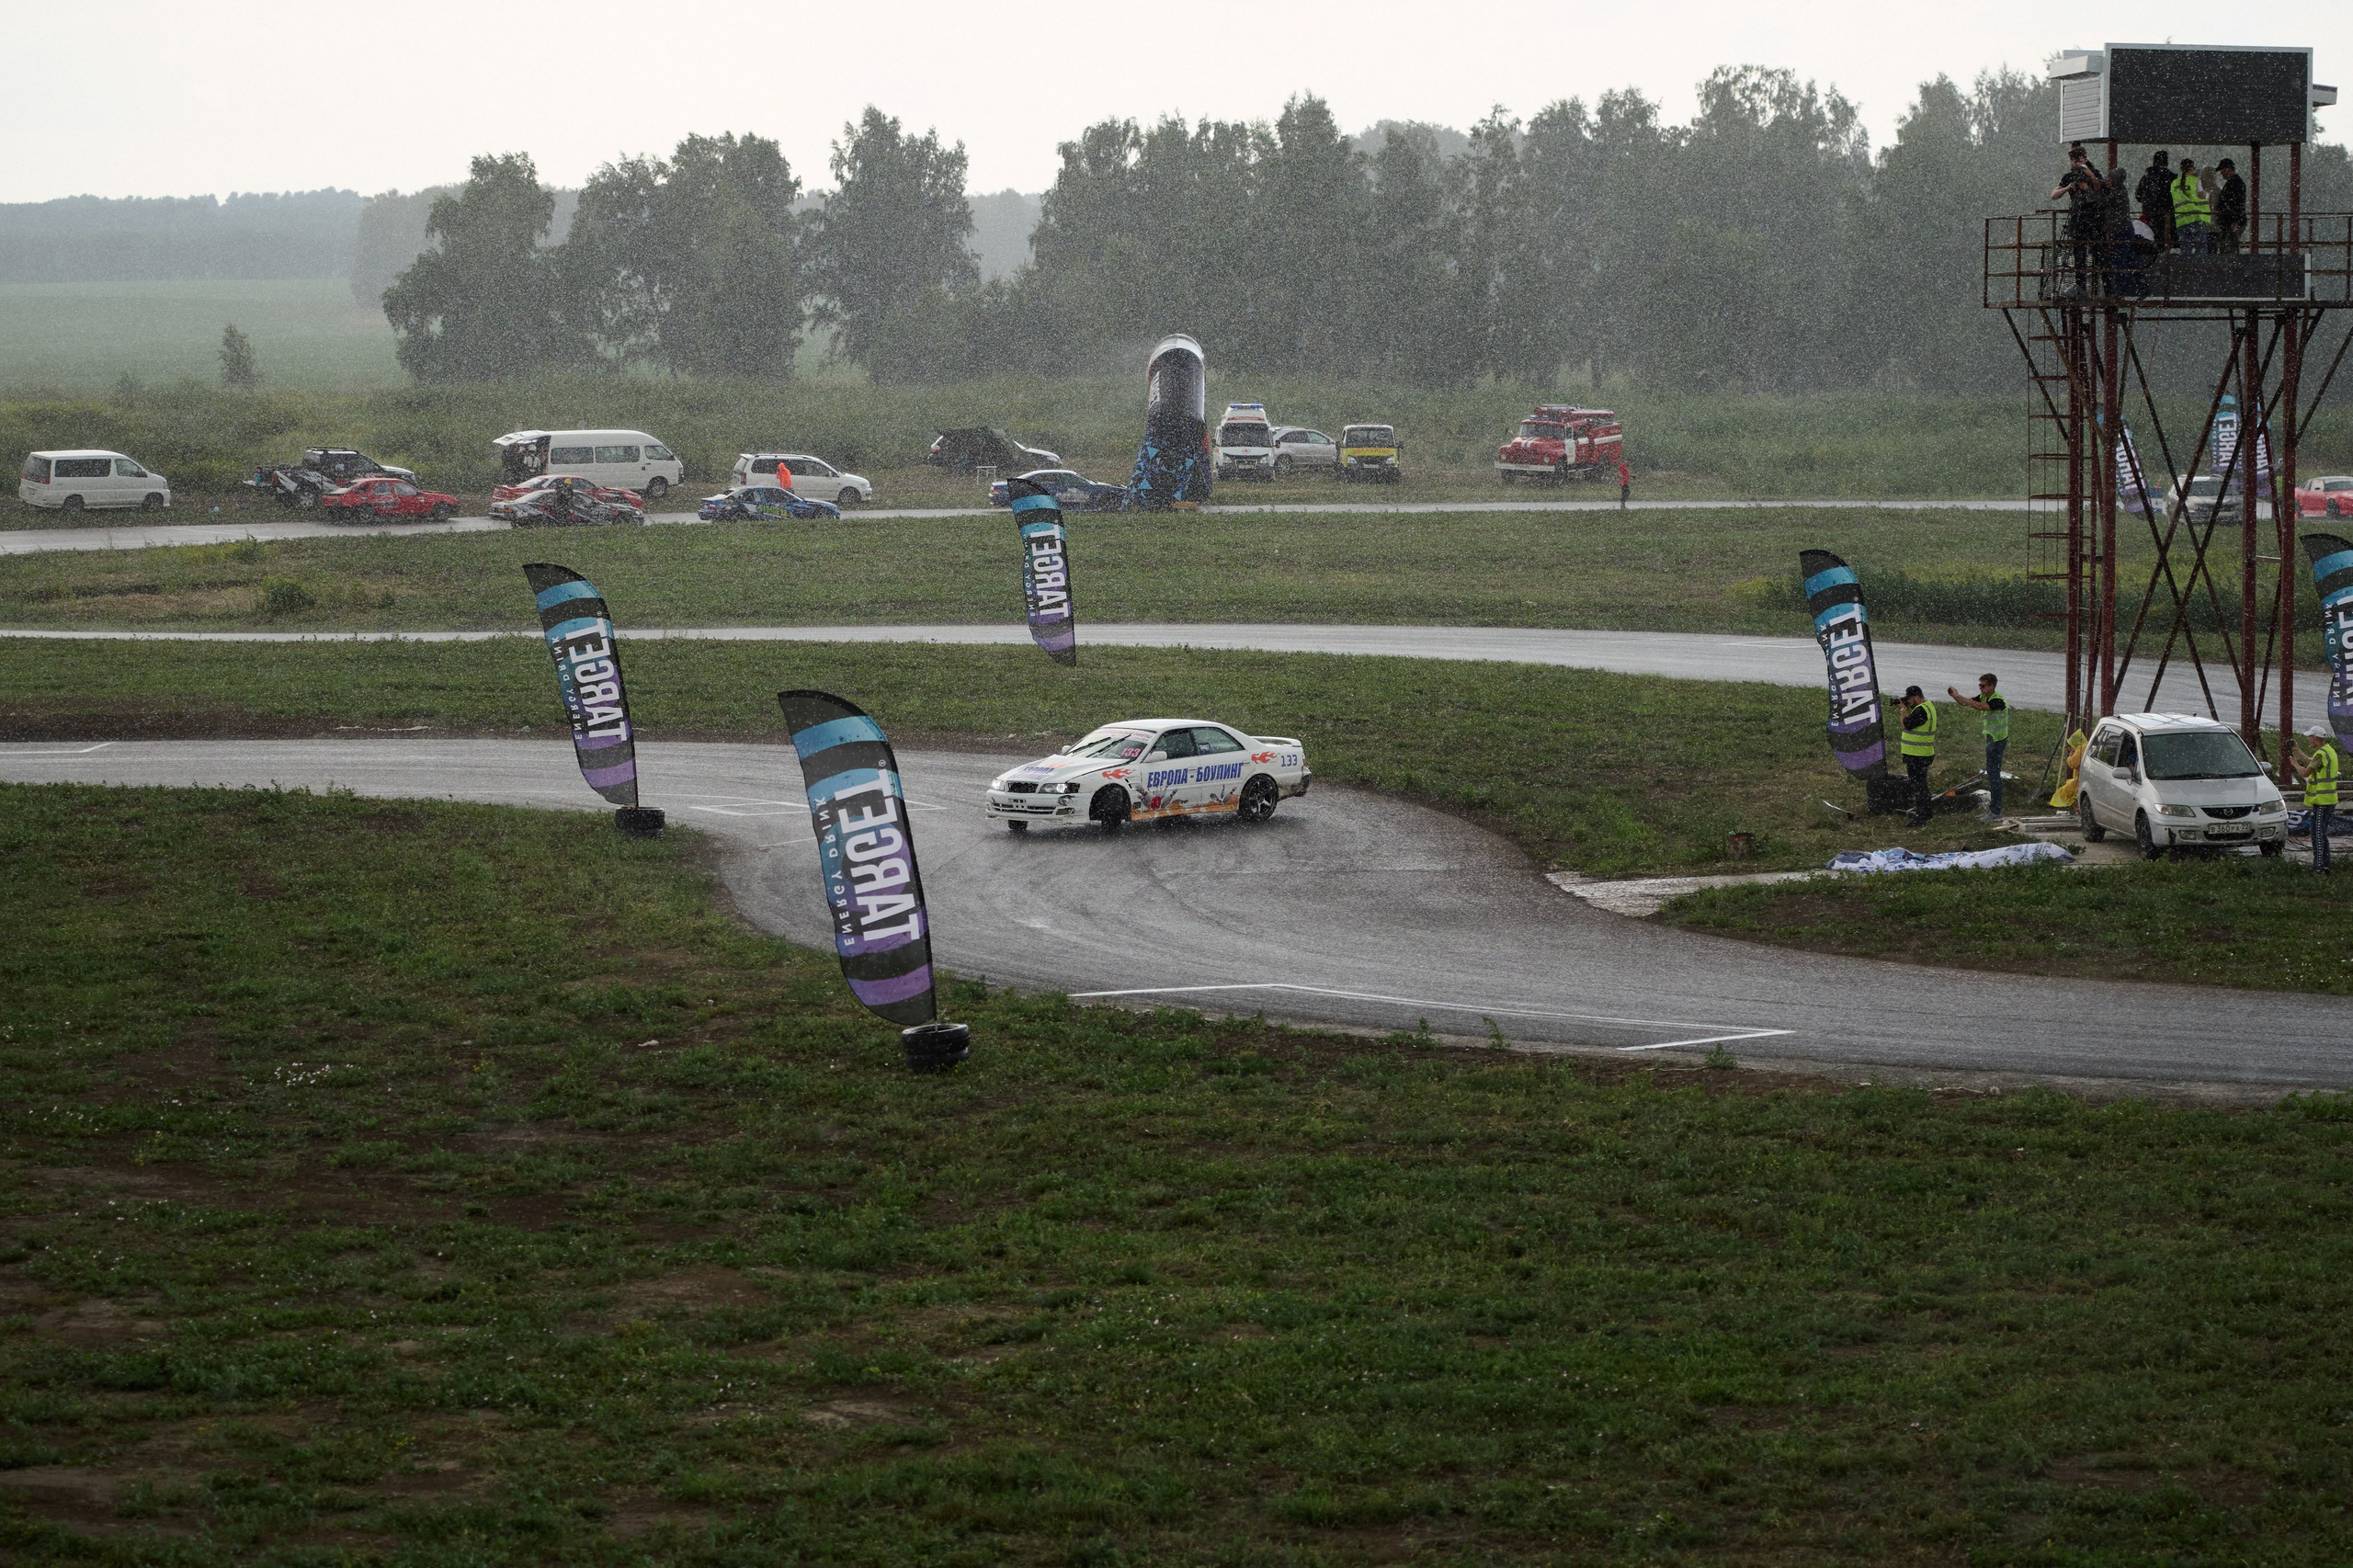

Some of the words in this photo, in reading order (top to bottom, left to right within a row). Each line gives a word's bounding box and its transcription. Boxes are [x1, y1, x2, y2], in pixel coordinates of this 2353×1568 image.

[1121, 747, 1141, 757] 133
[1281, 755, 1297, 767] 133
[1147, 768, 1188, 788] ЕВРОПА
[1196, 763, 1244, 782] БОУЛИНГ
